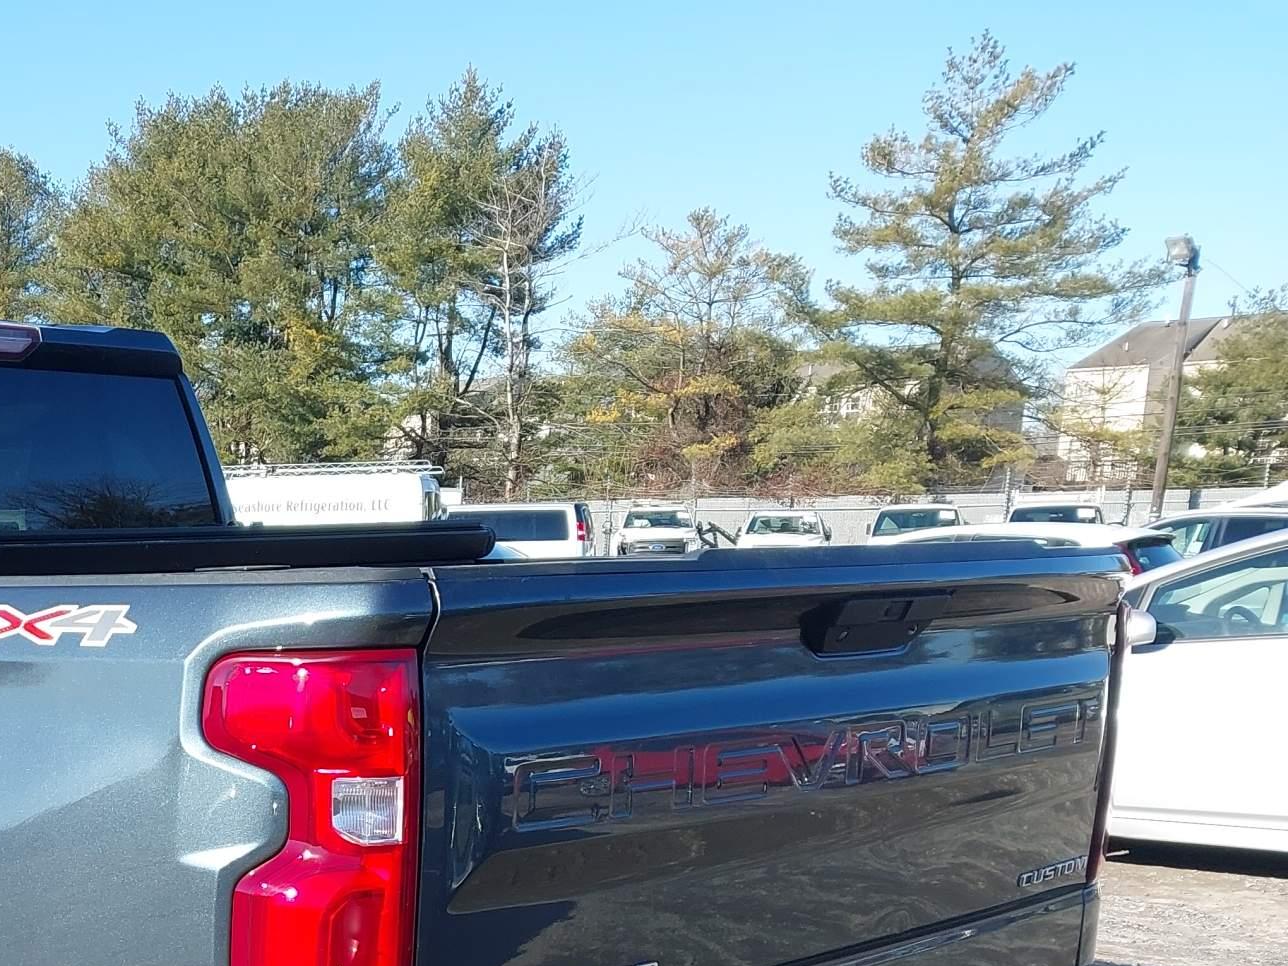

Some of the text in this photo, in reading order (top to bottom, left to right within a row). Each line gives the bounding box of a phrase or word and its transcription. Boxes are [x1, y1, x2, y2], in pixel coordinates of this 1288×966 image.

[371, 498, 392, 512] LLC
[512, 698, 1099, 833] CHEVROLET
[1019, 855, 1089, 887] CUSTOM
